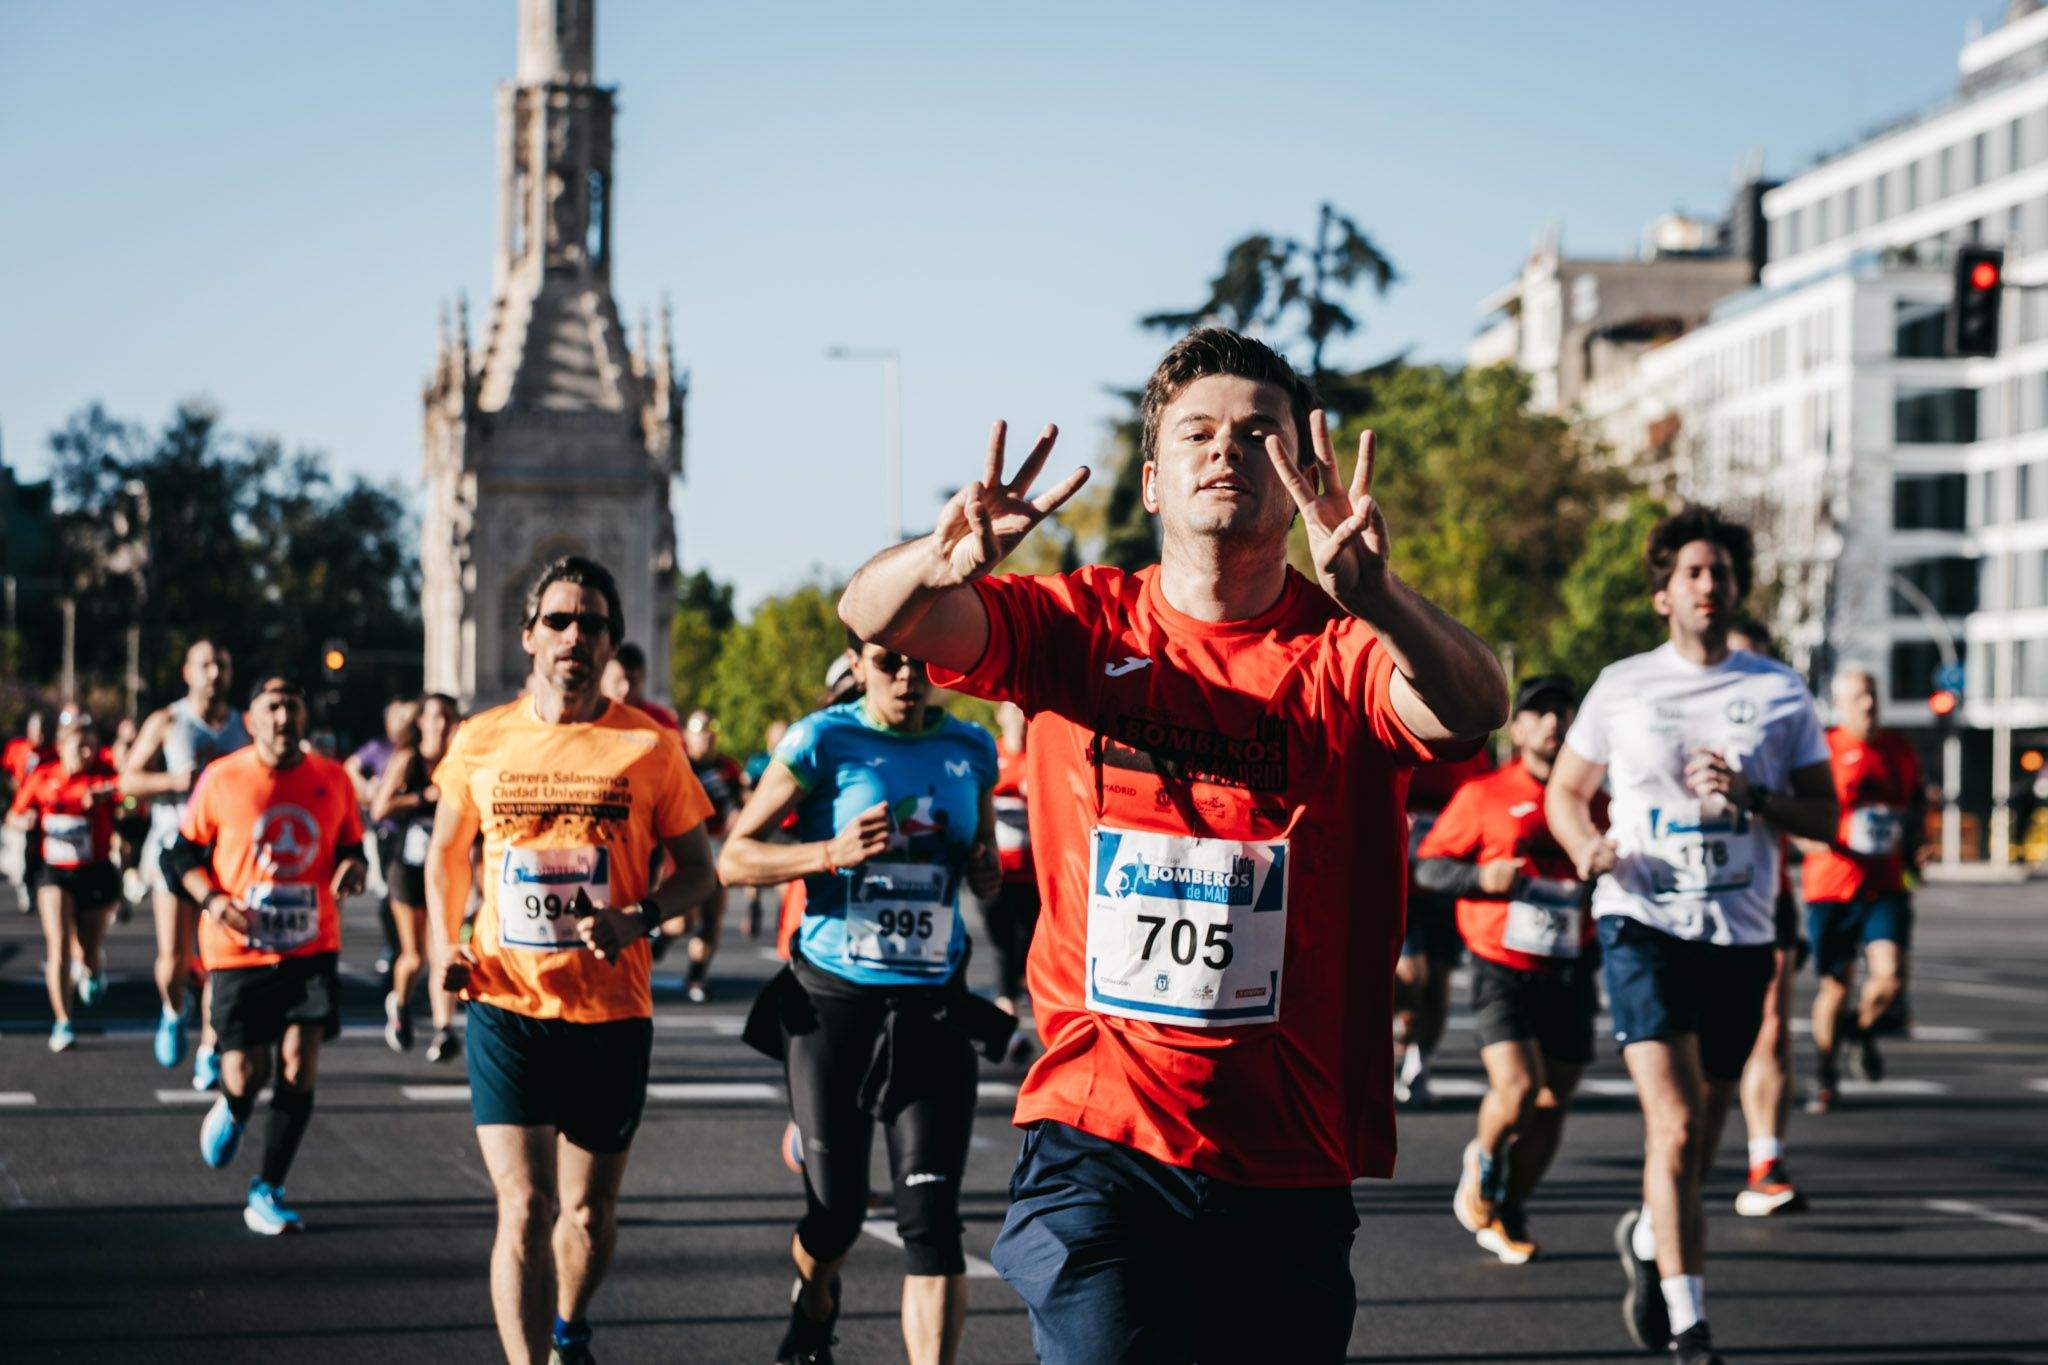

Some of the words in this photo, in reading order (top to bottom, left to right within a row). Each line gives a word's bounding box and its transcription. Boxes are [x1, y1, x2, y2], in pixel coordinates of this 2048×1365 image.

[498, 771, 549, 784] Carrera
[554, 770, 630, 788] Salamanca
[492, 785, 538, 799] Ciudad
[543, 787, 633, 804] Universitaria
[1147, 864, 1250, 888] BOMBEROS
[1186, 884, 1201, 900] de
[877, 908, 934, 940] 995
[1136, 914, 1234, 970] 705
